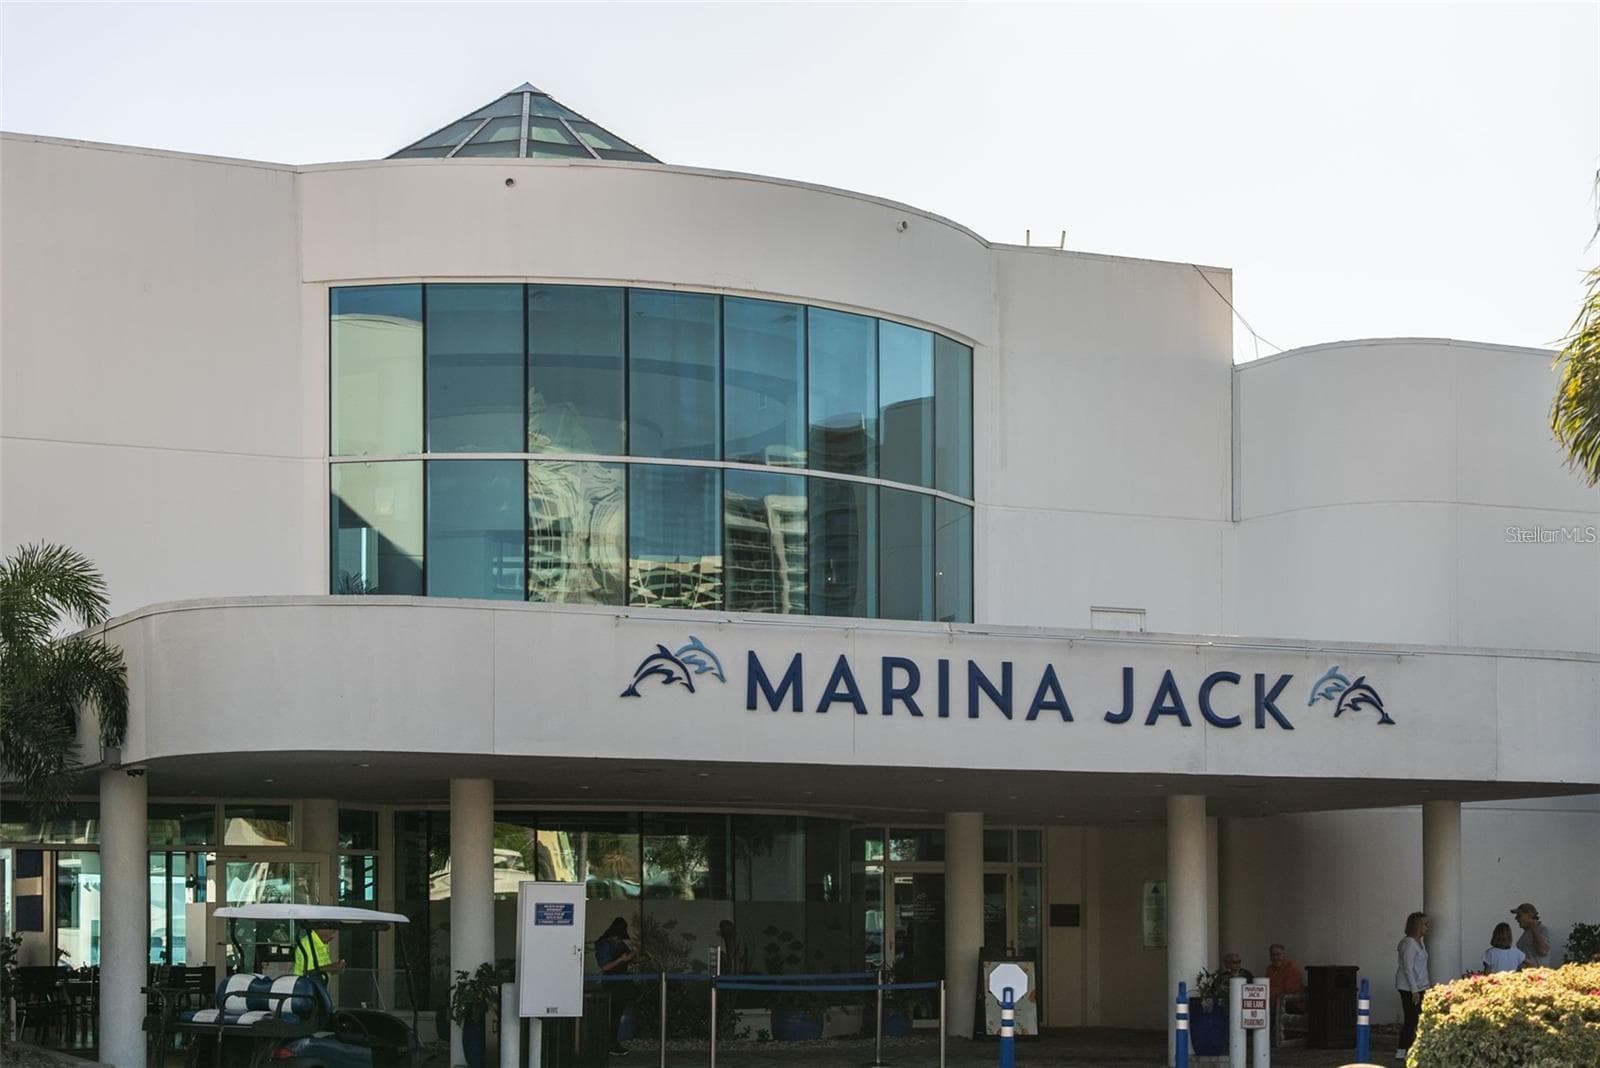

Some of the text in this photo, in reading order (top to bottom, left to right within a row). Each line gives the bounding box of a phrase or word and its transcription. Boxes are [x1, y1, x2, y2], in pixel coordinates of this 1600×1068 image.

[745, 649, 1295, 731] MARINA JACK
[1253, 1000, 1265, 1009] LANE
[1250, 1010, 1258, 1018] NO
